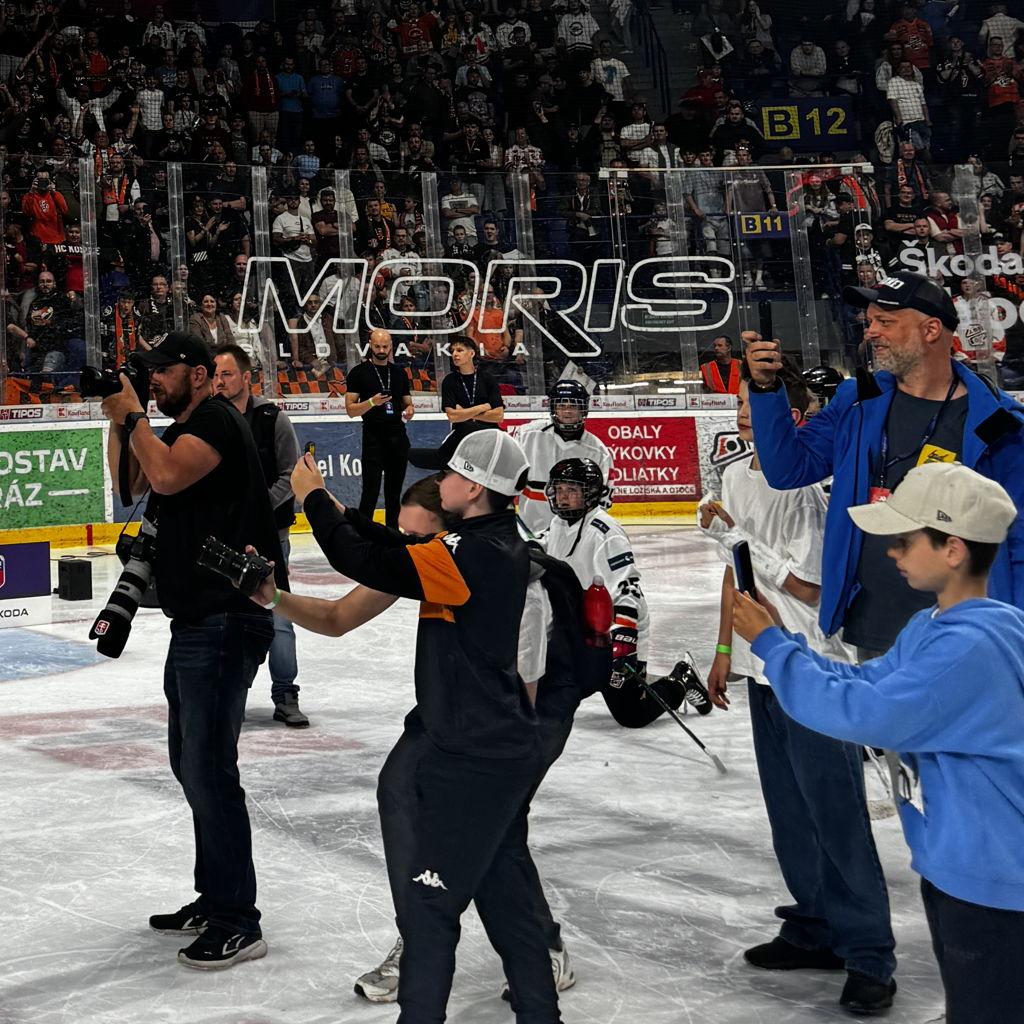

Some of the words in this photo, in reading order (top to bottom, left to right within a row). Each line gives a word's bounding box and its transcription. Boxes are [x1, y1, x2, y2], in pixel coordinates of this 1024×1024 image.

[805, 106, 849, 137] 12
[763, 214, 783, 232] 11
[899, 239, 1024, 277] Škoda
[237, 255, 735, 358] MORIS
[285, 402, 310, 410] TIPOS
[648, 398, 675, 407] TIPOS
[12, 408, 42, 419] TIPOS
[607, 425, 663, 441] OBALY
[610, 441, 677, 461] ÝKOVKY
[614, 466, 679, 482] OLIATKY
